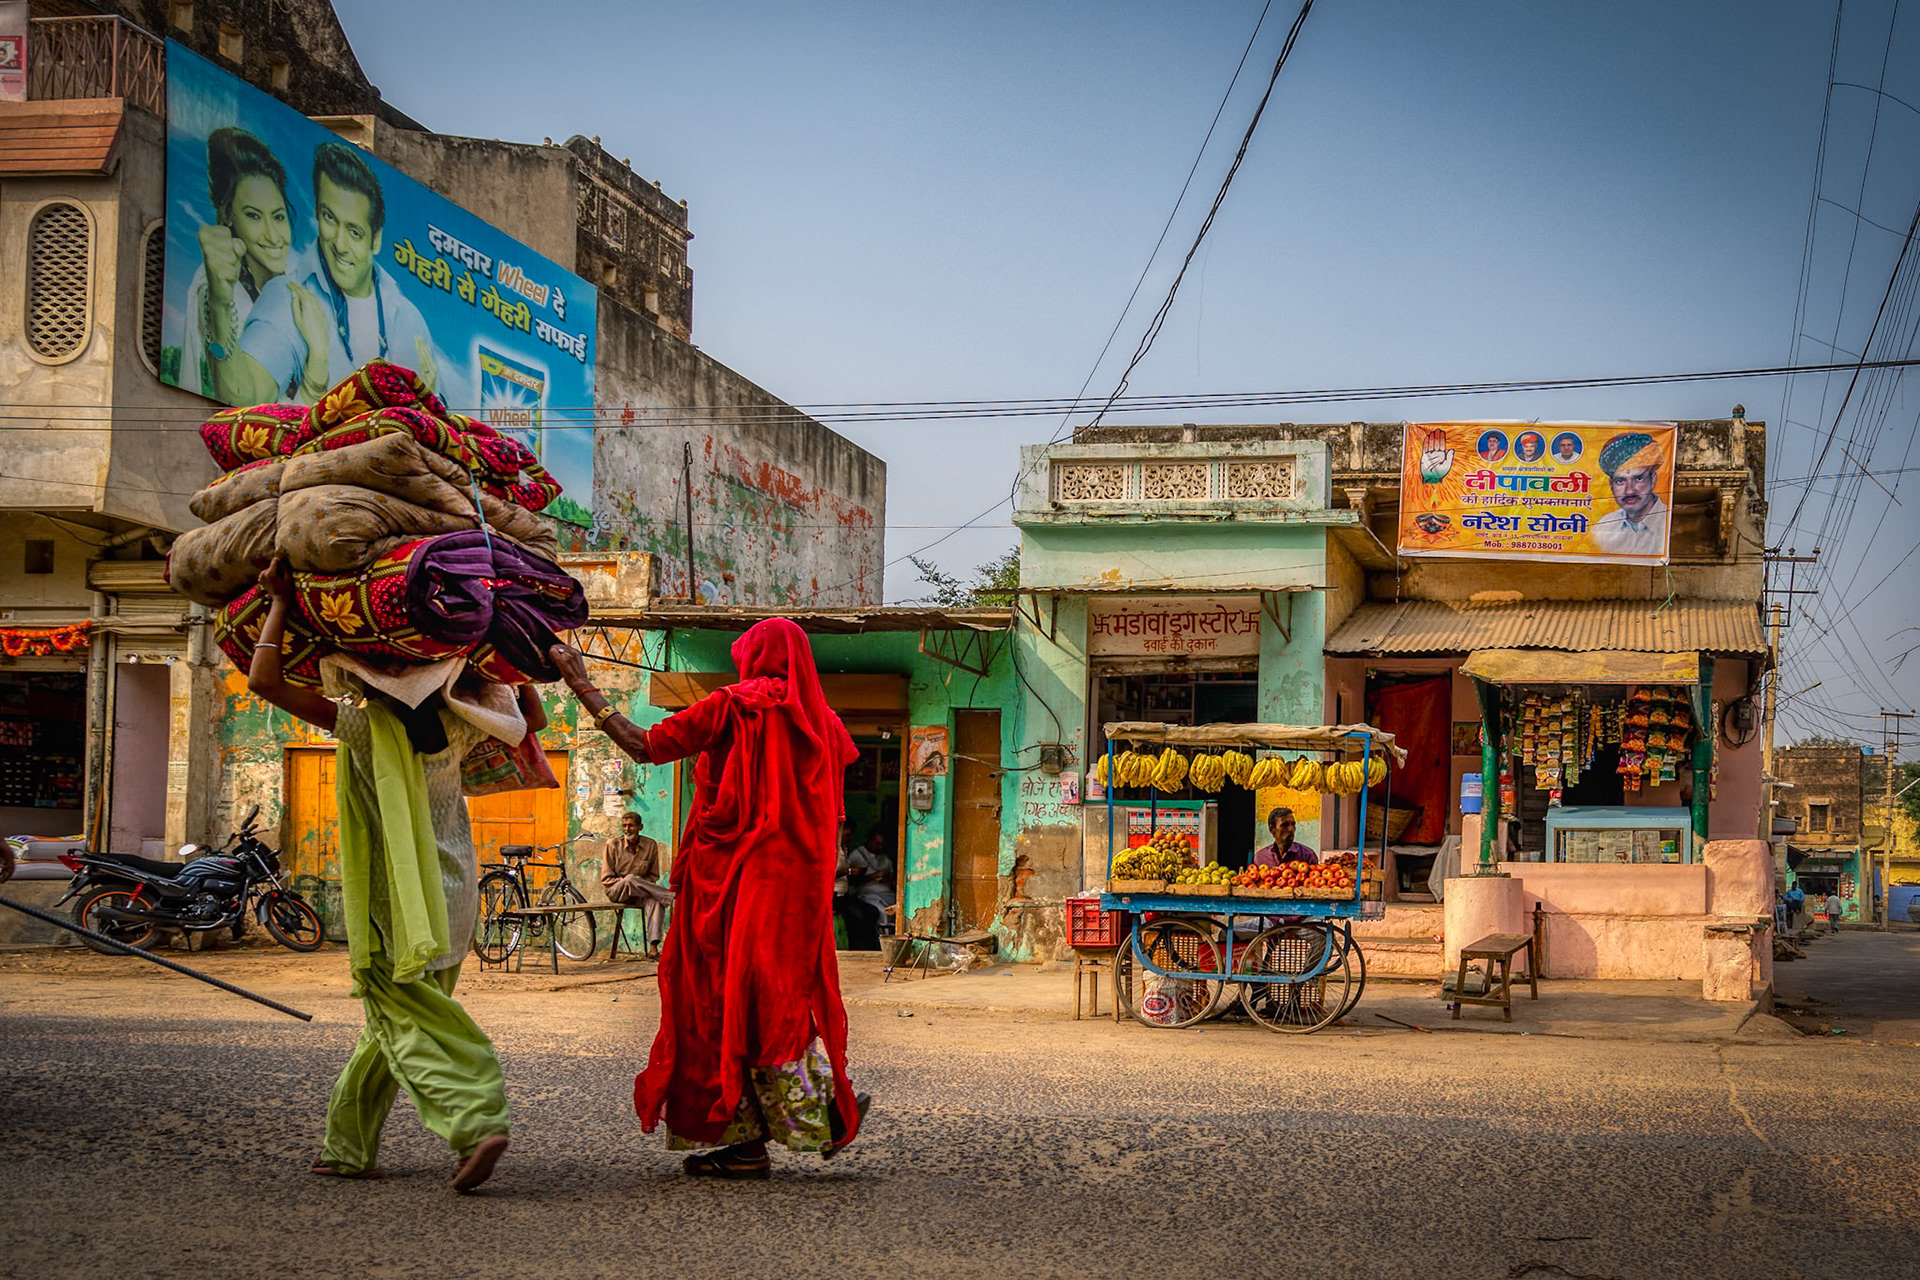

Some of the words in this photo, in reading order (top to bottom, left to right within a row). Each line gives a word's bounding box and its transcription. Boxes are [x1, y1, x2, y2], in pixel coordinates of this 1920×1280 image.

[428, 223, 493, 276] दमदार
[498, 261, 548, 307] Wheel
[552, 286, 566, 320] दे
[394, 238, 452, 292] गेहरी
[457, 271, 477, 304] से
[481, 285, 531, 333] गेहरी
[536, 318, 587, 363] सफाई
[489, 407, 531, 426] Wheel
[1464, 469, 1592, 493] दीपावली
[1462, 493, 1478, 504] की
[1482, 493, 1519, 506] हार्दिक
[1521, 495, 1593, 510] शुभकामनाएँ
[1461, 511, 1522, 531] नरेश
[1526, 513, 1589, 533] सोनी
[1484, 540, 1504, 548] Mob.
[1511, 541, 1563, 550] 9887038001
[1113, 607, 1169, 637] मंडावा
[1200, 604, 1241, 635] स्टोर
[1143, 636, 1169, 652] दवाई
[1170, 636, 1185, 651] की
